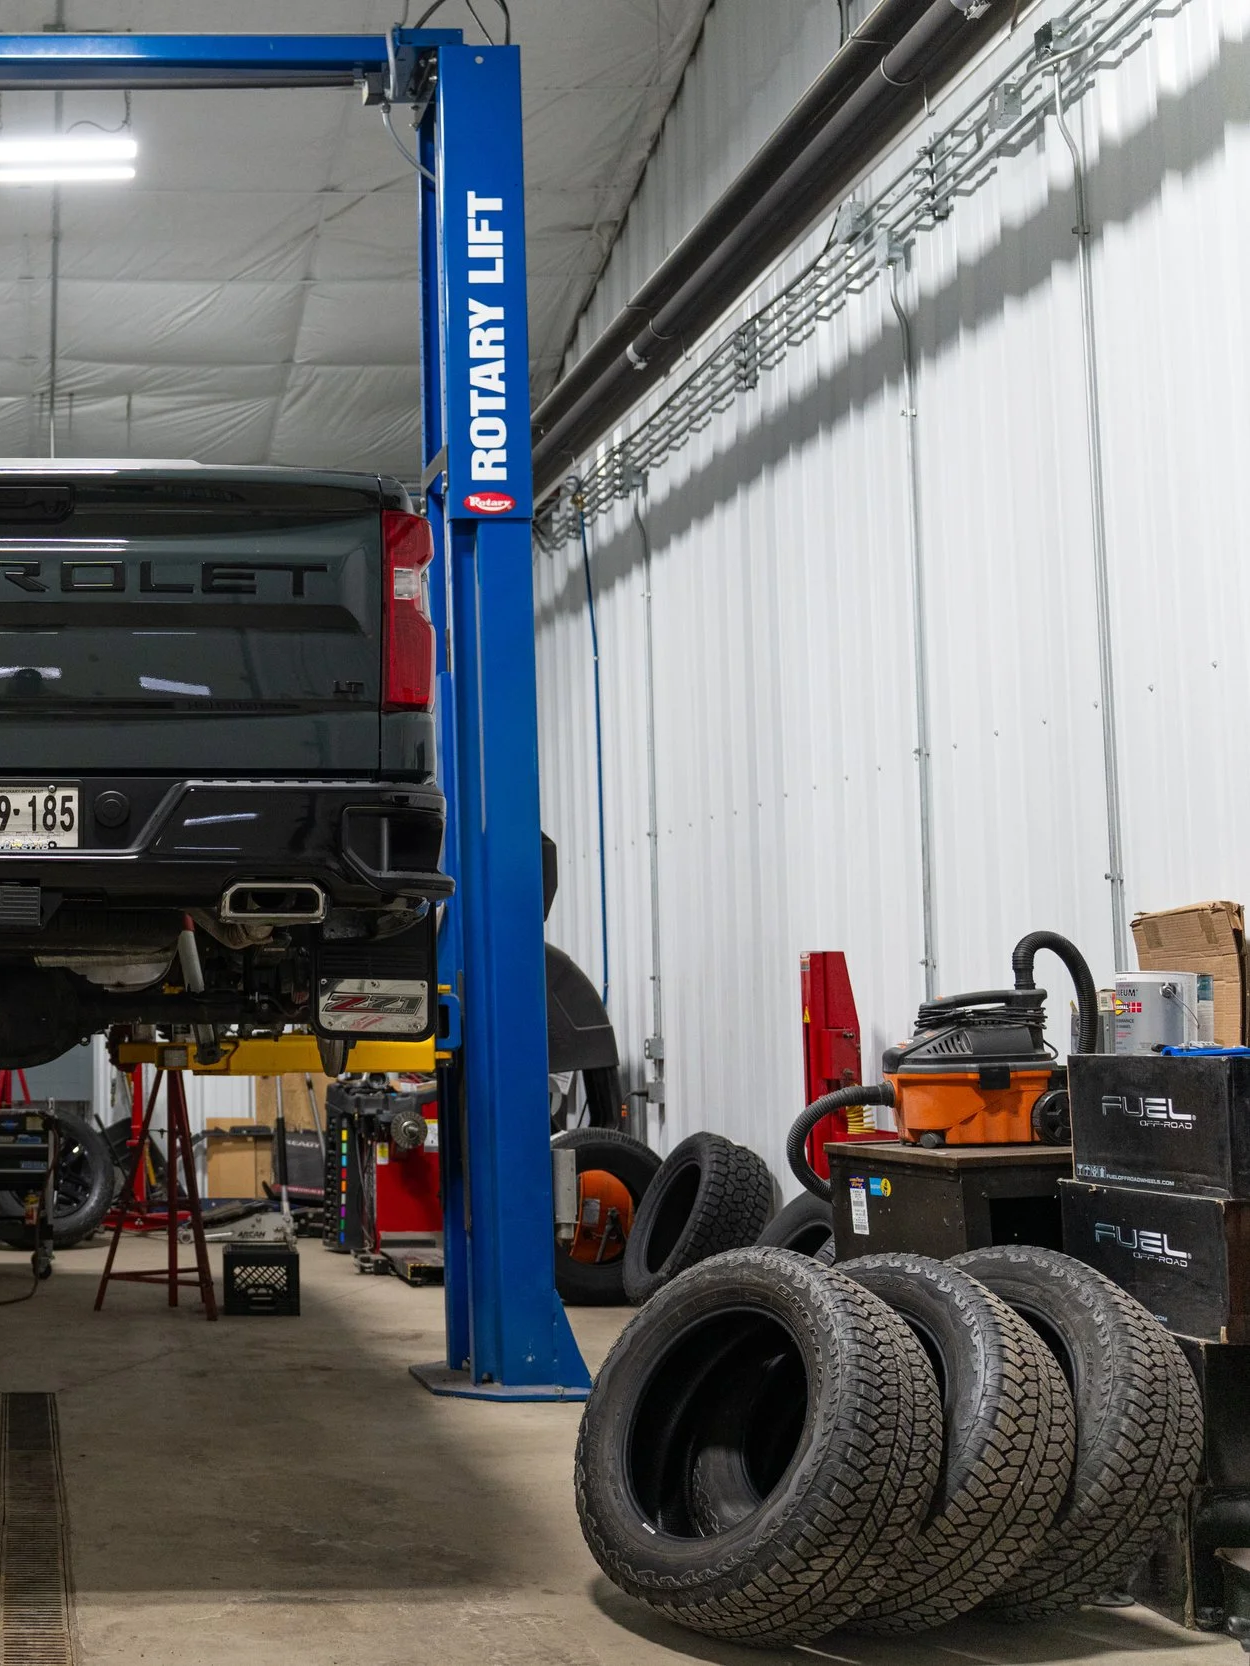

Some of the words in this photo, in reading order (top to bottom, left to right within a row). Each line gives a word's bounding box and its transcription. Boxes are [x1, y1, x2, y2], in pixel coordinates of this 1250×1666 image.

[467, 190, 504, 284] LIFT
[468, 297, 507, 481] ROTARY
[469, 496, 511, 511] Rotary
[322, 992, 423, 1015] Z71
[1102, 1095, 1192, 1121] FUEL
[1139, 1120, 1193, 1130] OFF-ROAD
[1094, 1222, 1188, 1259] FUEL
[1133, 1251, 1188, 1268] OFF-ROAD
